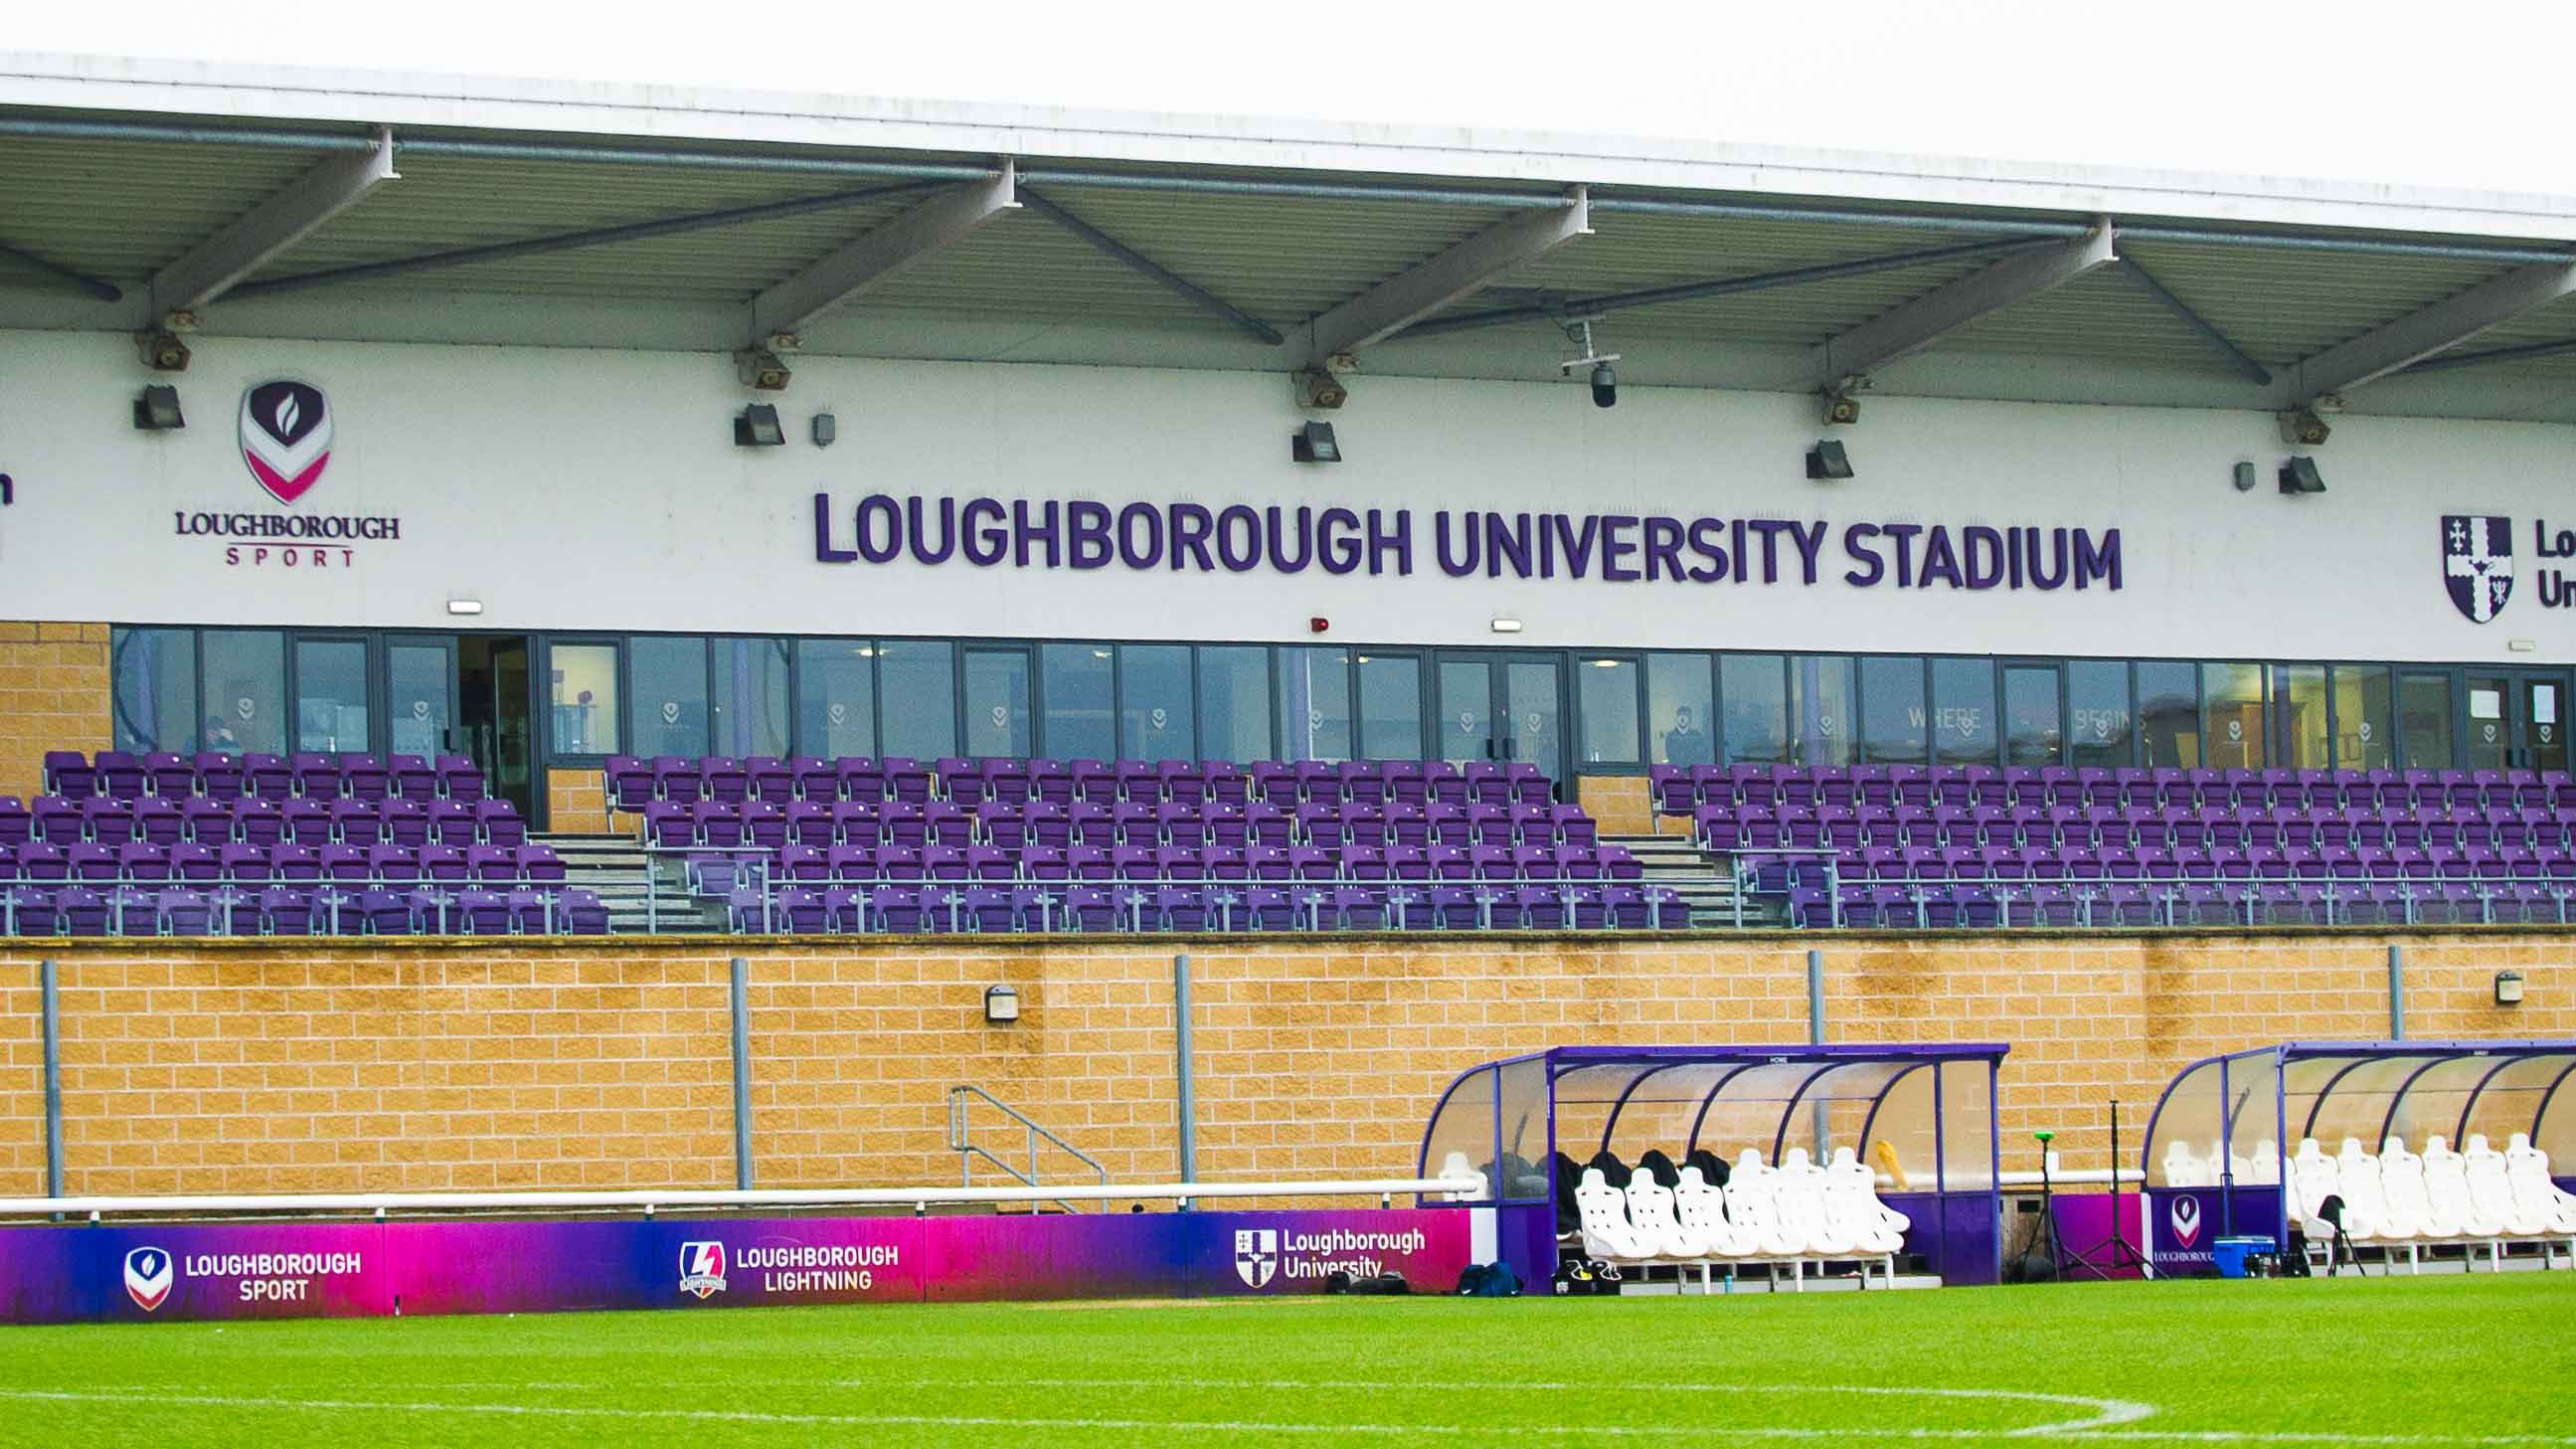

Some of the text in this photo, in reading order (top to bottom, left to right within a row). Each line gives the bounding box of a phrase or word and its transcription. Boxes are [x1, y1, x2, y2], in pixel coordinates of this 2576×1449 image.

[175, 511, 400, 540] LOUGHBOROUGH
[815, 493, 2124, 591] LOUGHBOROUGH UNIVERSITY STADIUM
[226, 547, 353, 567] SPORT
[1284, 1228, 1426, 1256] Loughborough
[185, 1252, 362, 1276] LOUGHBOROUGH
[737, 1245, 899, 1268] LOUGHBOROUGH
[2154, 1250, 2216, 1263] LOUGHBOROUG
[239, 1279, 309, 1301] SPORT
[765, 1271, 872, 1292] LIGHTNING
